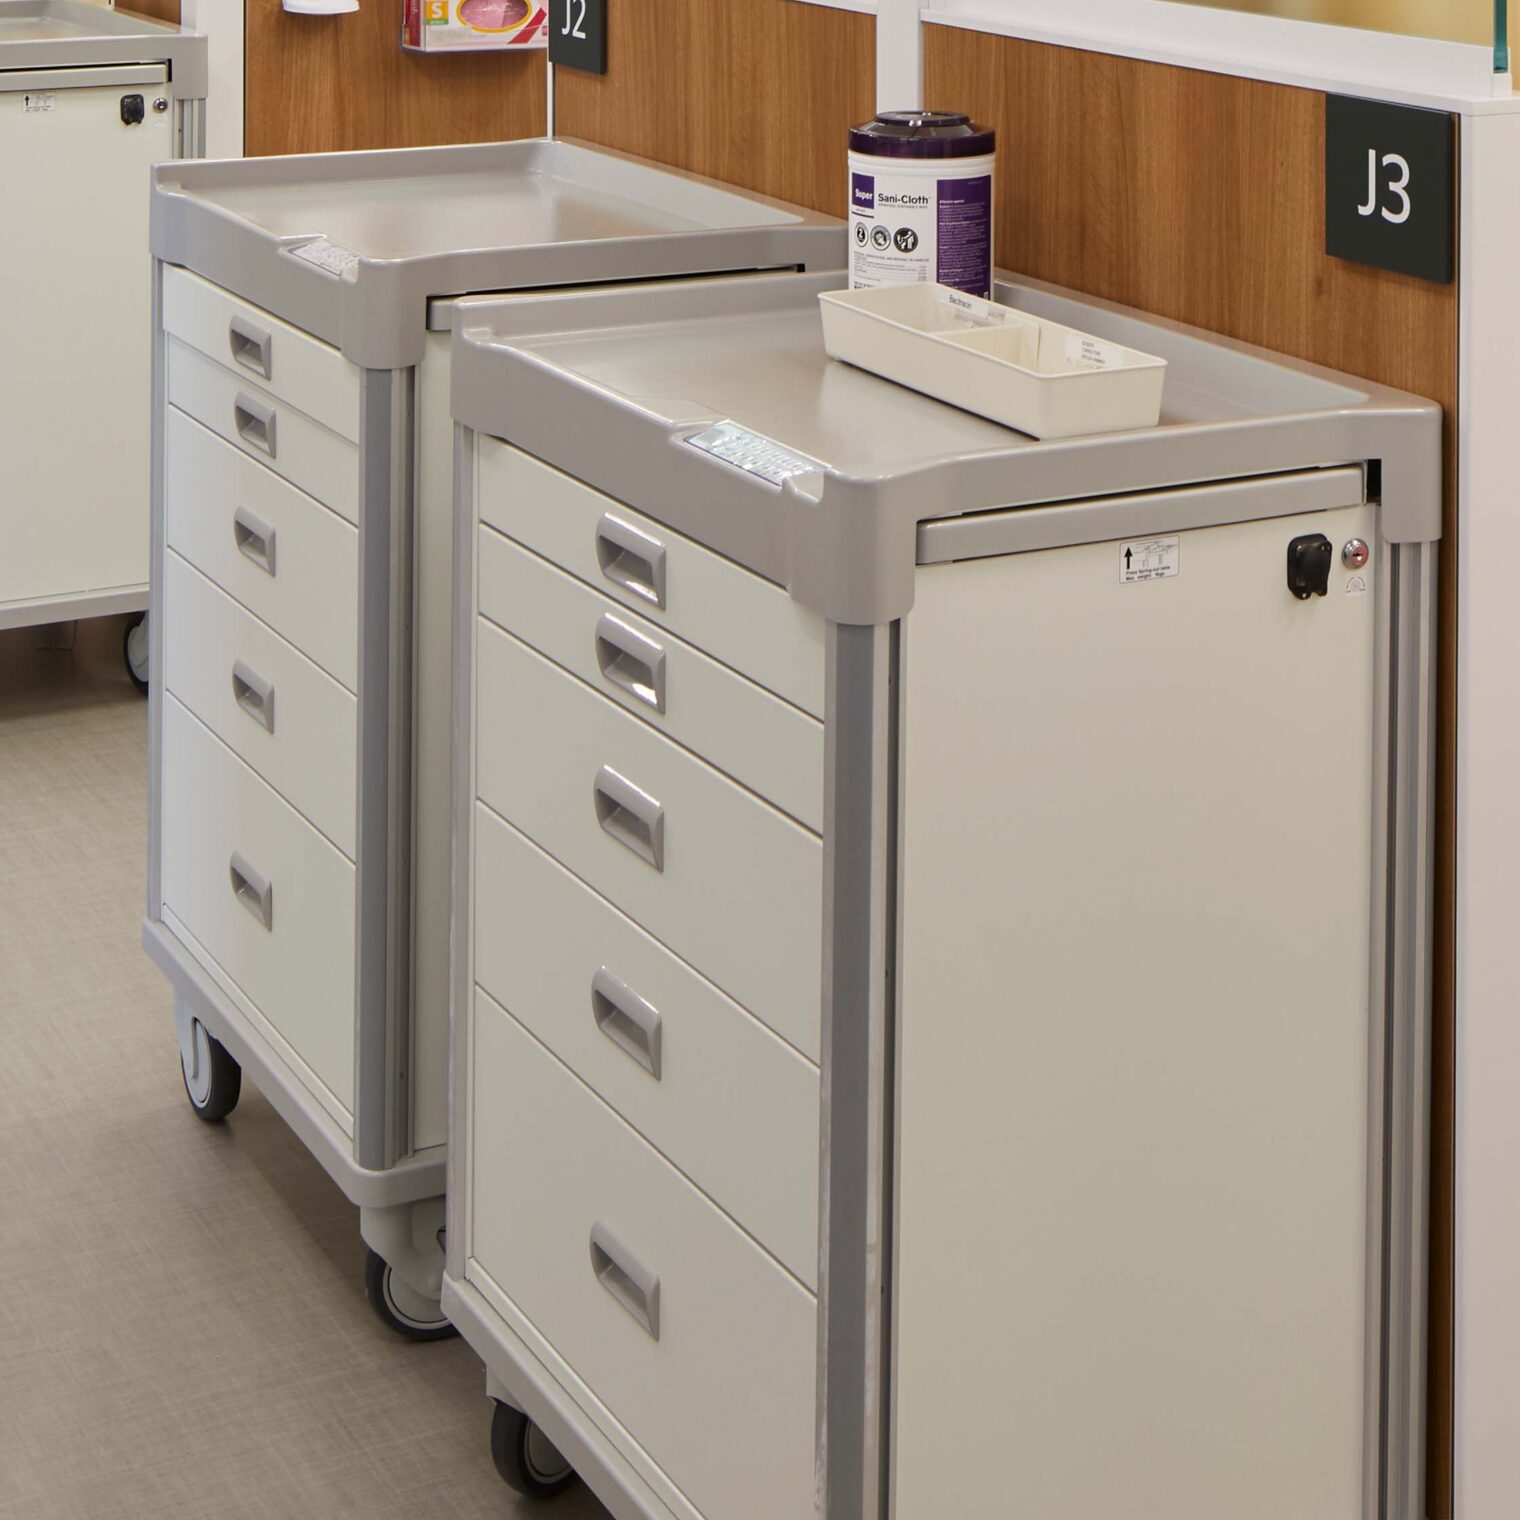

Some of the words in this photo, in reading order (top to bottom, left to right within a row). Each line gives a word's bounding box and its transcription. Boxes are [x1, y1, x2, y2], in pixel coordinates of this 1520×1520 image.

[432, 2, 442, 18] S
[1358, 148, 1411, 223] J3
[855, 188, 873, 201] Super
[878, 193, 929, 205] Sani-Cloth
